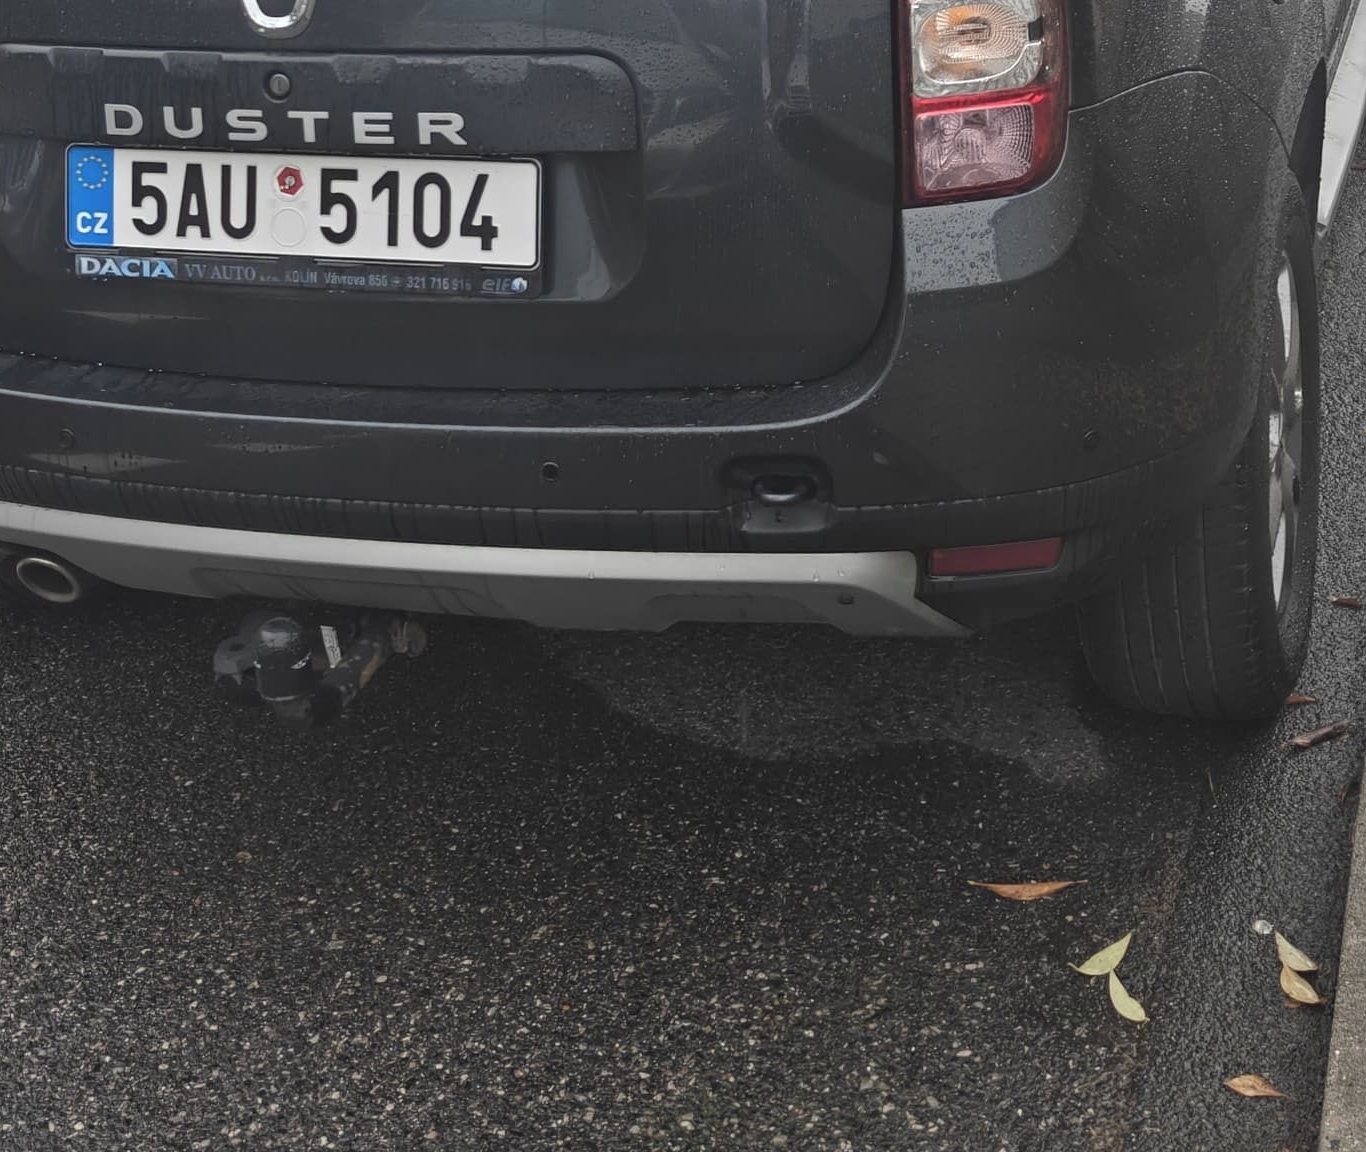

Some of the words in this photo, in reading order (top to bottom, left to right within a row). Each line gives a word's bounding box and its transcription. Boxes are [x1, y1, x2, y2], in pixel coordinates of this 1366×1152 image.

[103, 103, 468, 146] DUSTER
[131, 160, 258, 241] 5AU
[319, 168, 499, 252] 5104
[75, 211, 109, 235] CZ
[79, 256, 176, 279] DACIA
[210, 264, 257, 281] AUTO
